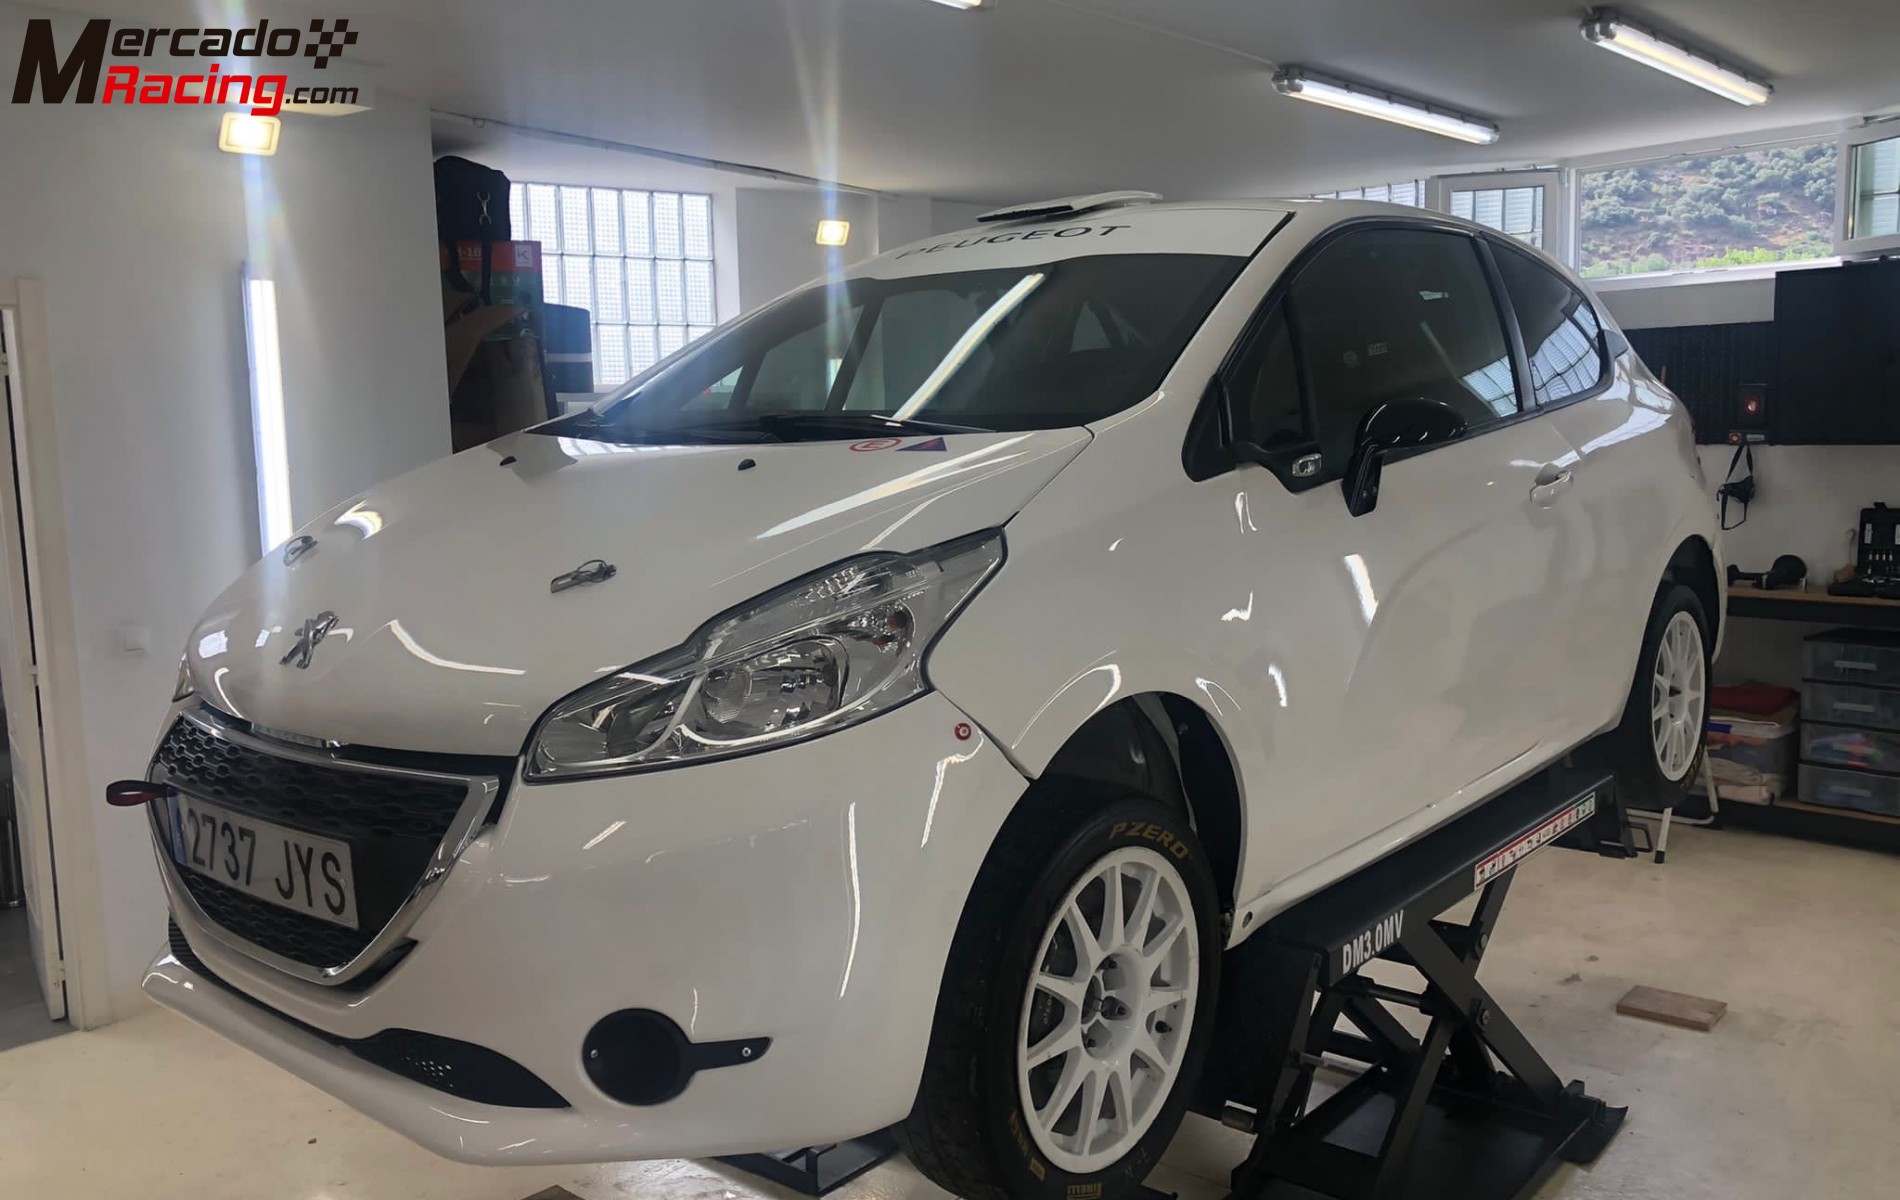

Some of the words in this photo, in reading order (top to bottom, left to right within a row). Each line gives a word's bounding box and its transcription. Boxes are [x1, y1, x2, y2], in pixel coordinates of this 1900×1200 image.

[896, 225, 1131, 259] PEUGEOT
[188, 808, 256, 886] 2737
[275, 839, 347, 916] JYS
[1342, 909, 1404, 975] DM3.0MV
